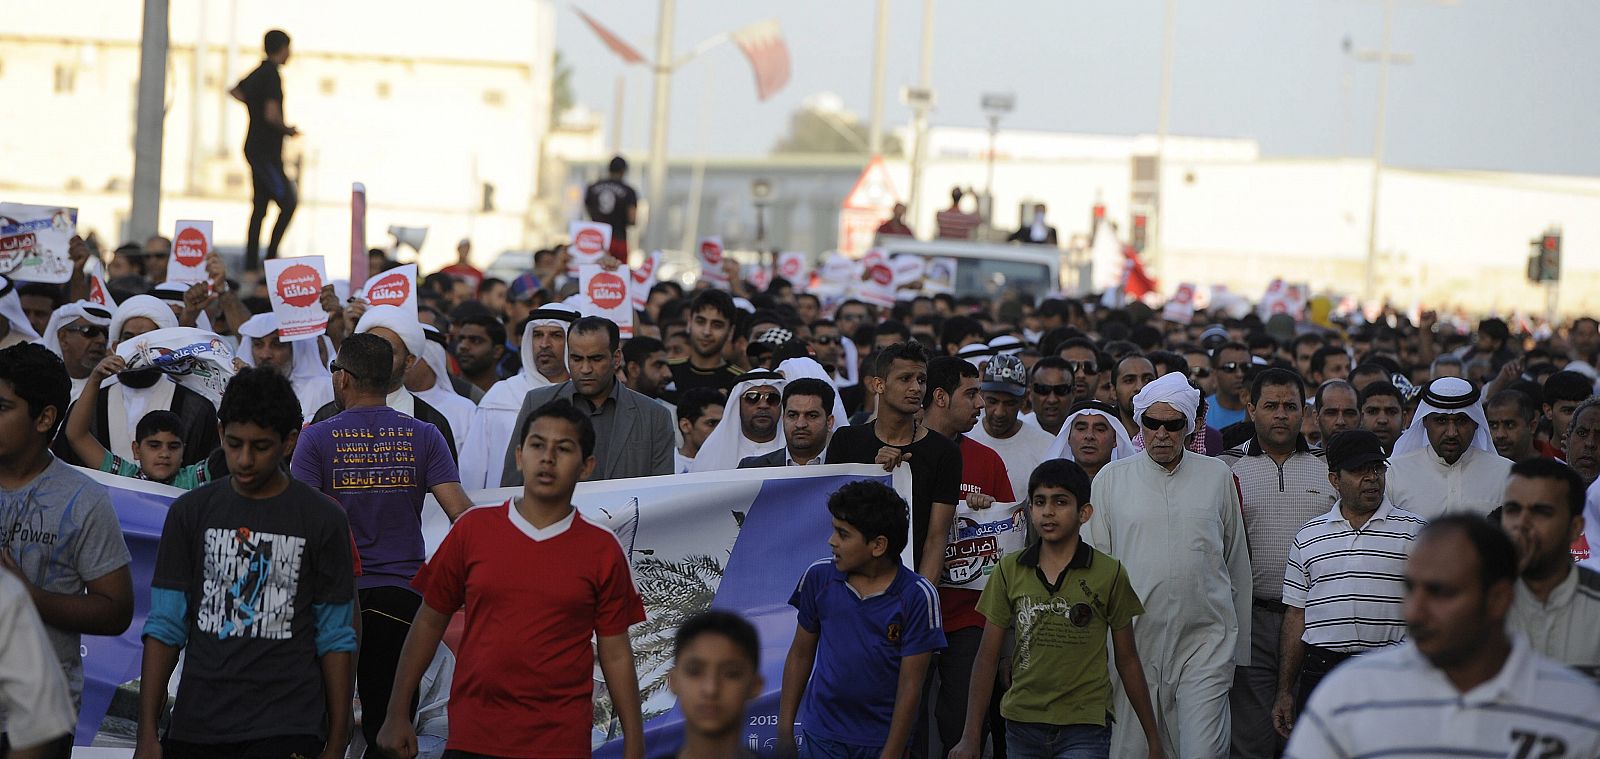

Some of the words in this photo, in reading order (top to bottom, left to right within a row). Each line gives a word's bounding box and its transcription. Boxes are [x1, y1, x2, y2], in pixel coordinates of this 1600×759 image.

[379, 427, 414, 437] CREW
[336, 442, 369, 453] LUXURY
[11, 522, 58, 545] Power
[961, 539, 995, 556] إضراب
[204, 554, 302, 584] SHOWIME
[953, 568, 968, 579] 14
[749, 715, 778, 726] 2013
